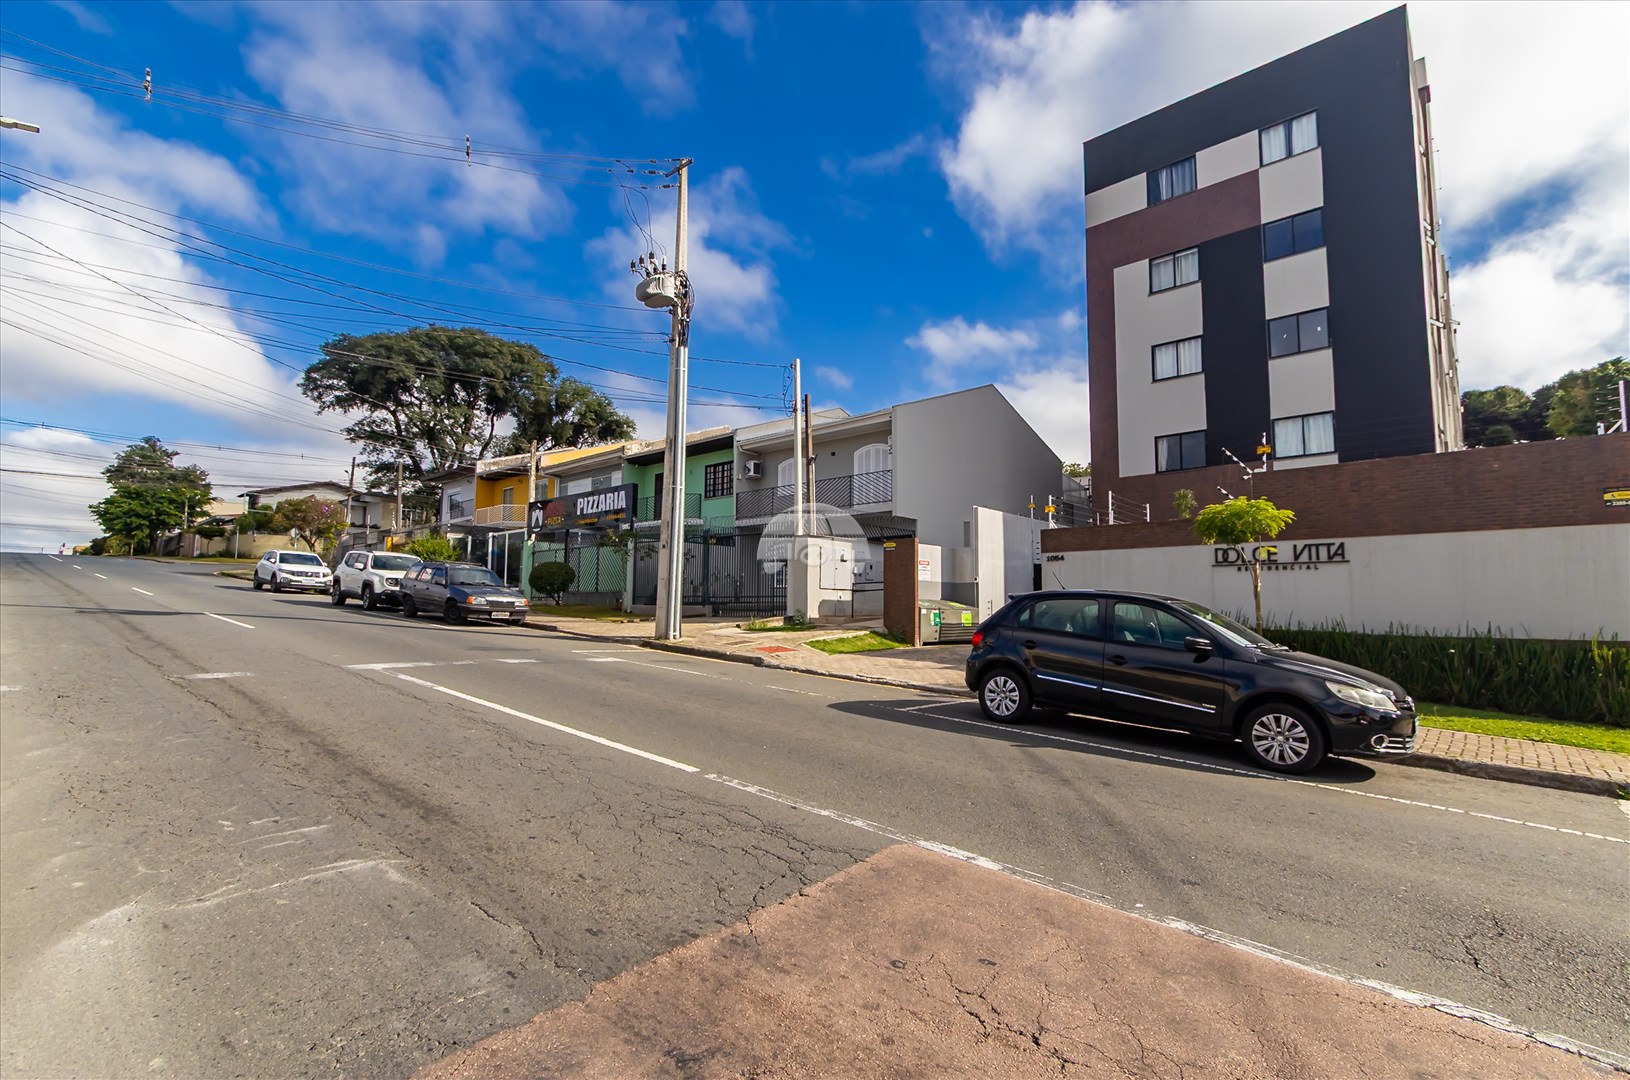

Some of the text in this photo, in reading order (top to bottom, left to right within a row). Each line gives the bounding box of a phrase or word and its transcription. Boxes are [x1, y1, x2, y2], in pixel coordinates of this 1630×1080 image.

[577, 491, 626, 515] PIZZARIA
[1046, 554, 1065, 562] 1054
[1214, 542, 1346, 564] DOLCE VITTA
[1237, 564, 1319, 572] REIDENCIAL
